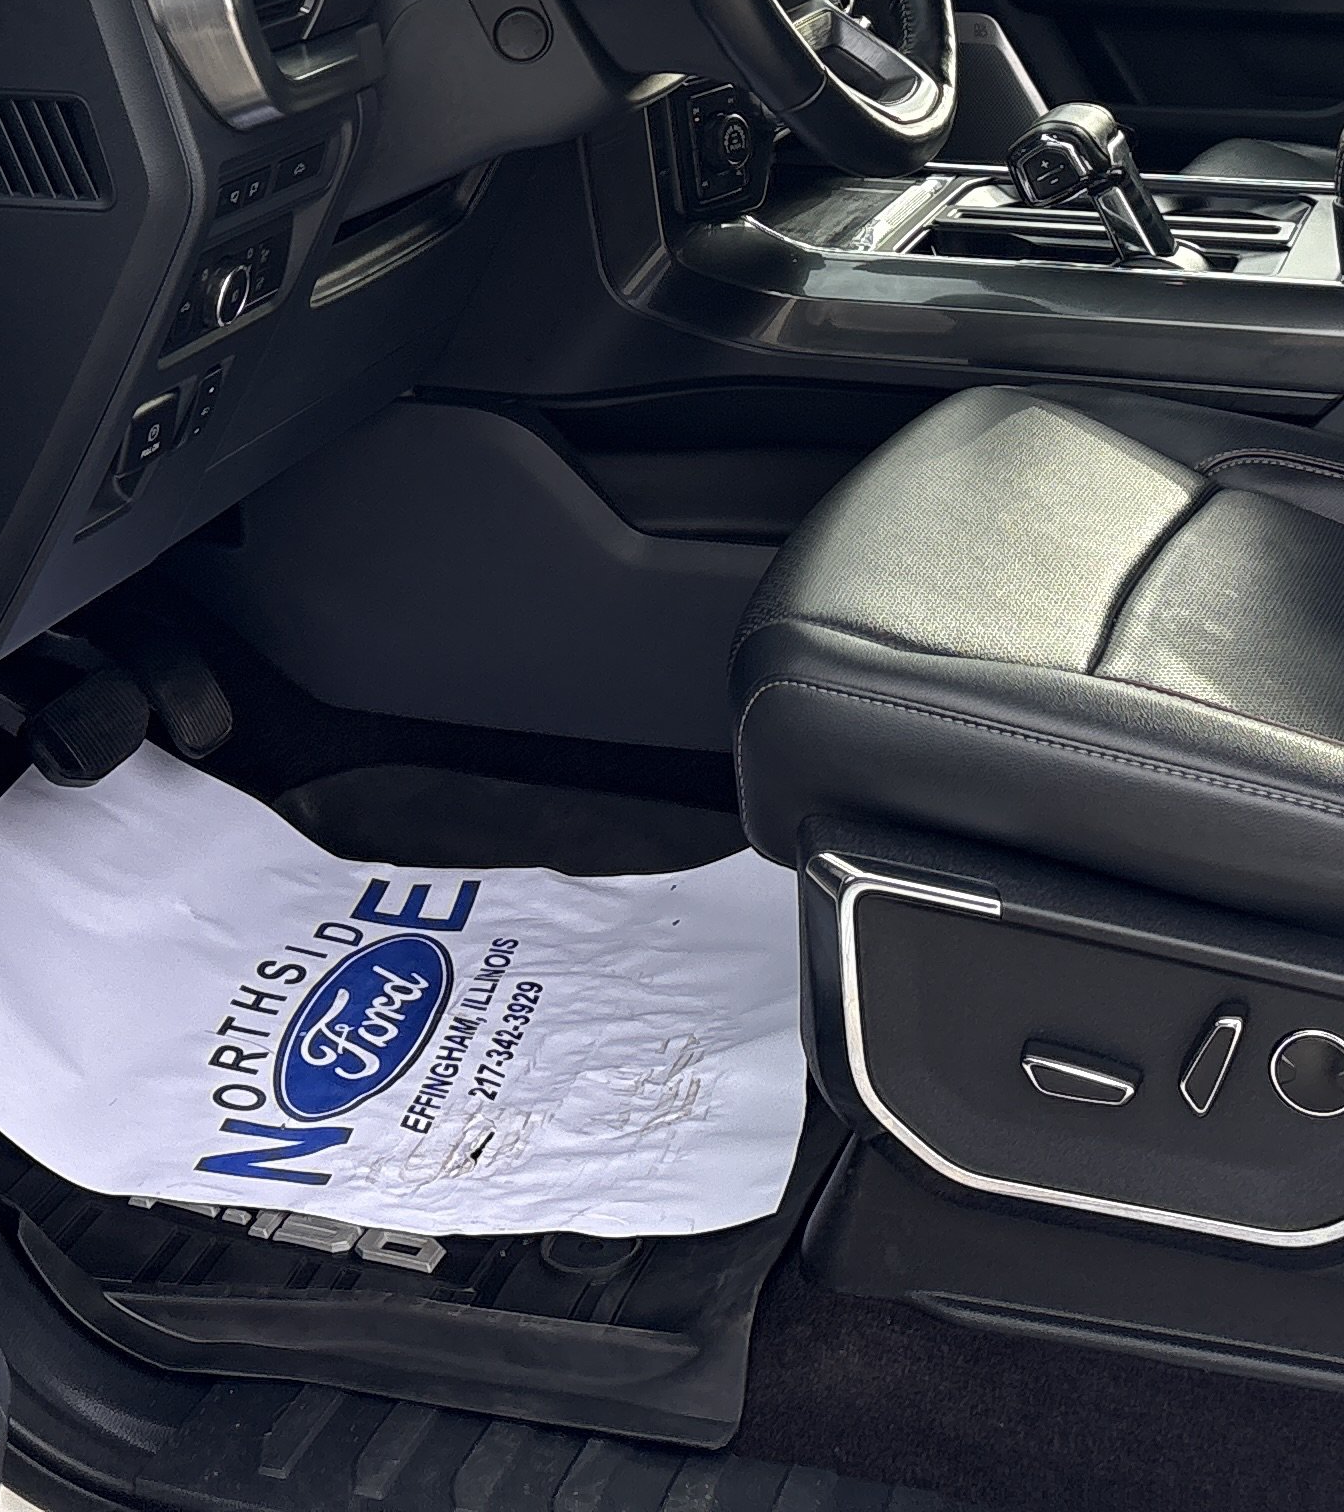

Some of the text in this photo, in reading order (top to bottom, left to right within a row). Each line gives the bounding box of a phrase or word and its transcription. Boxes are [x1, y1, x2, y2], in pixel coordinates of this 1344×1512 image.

[300, 965, 431, 1081] Ford
[399, 936, 520, 1135] EFFINGHAM, ILLINOIS
[467, 981, 544, 1102] 217-342-3929
